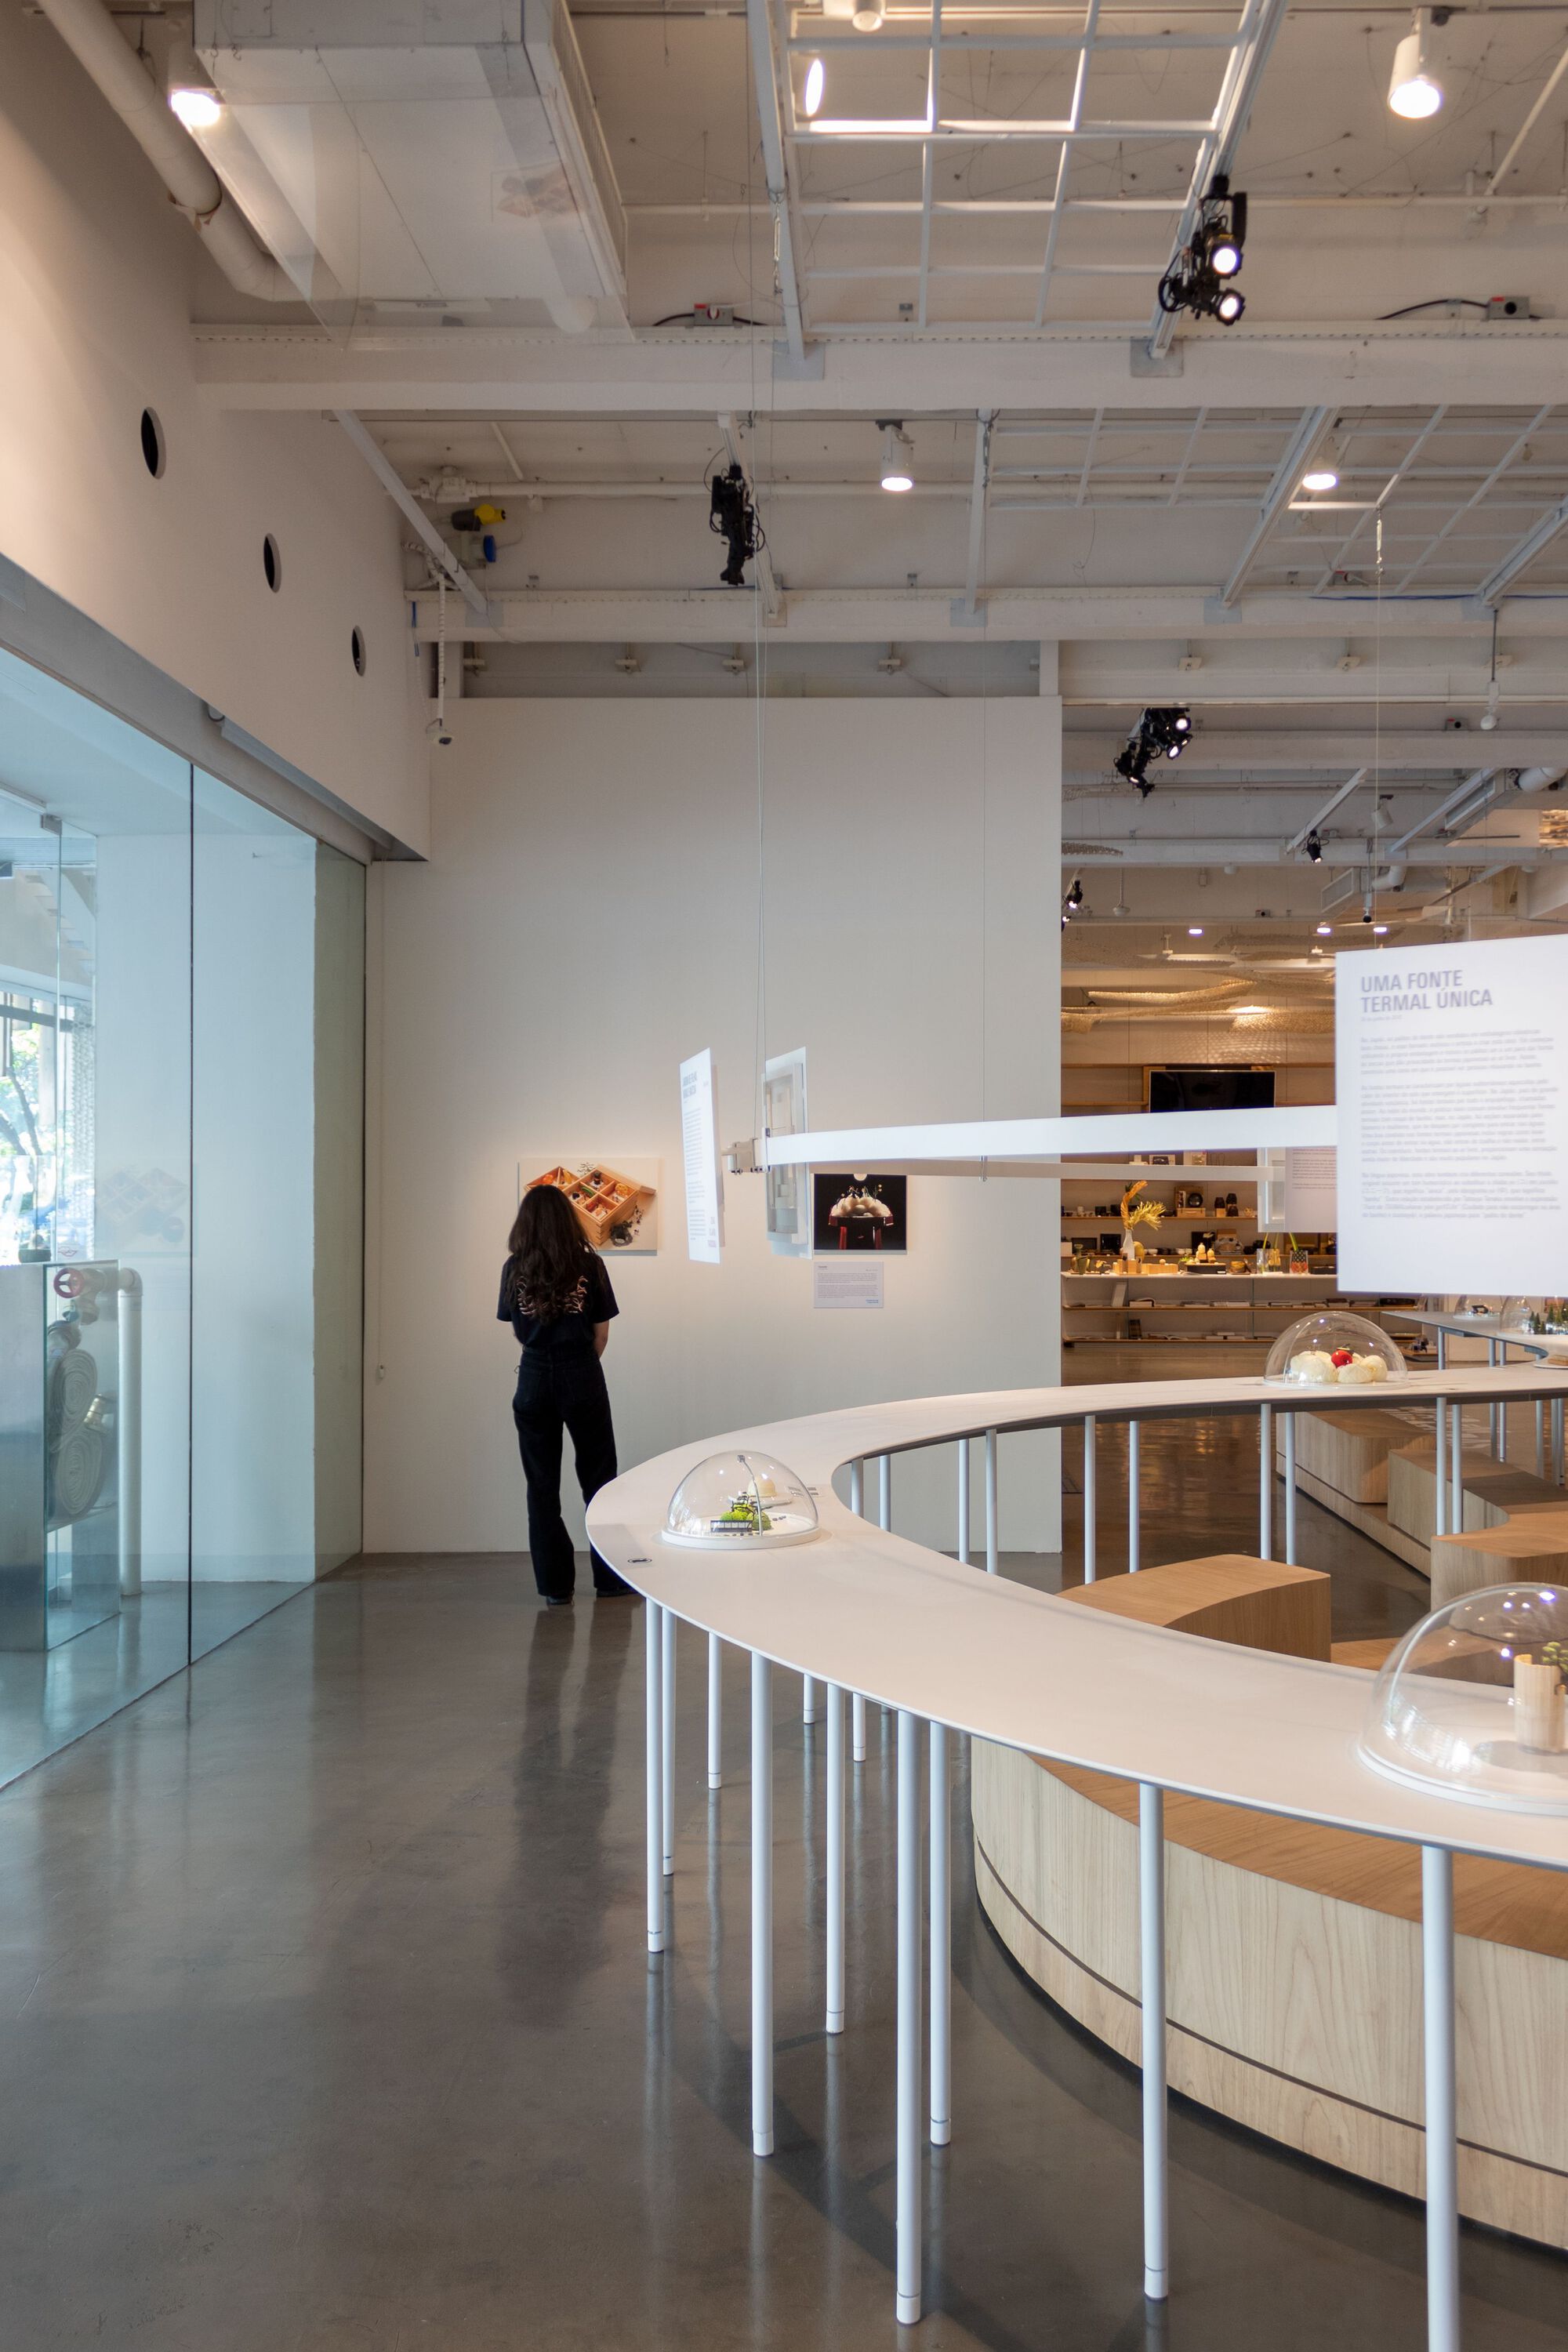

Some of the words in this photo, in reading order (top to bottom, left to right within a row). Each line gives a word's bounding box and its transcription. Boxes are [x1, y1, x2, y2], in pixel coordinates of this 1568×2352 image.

[1361, 975, 1402, 993] UMA
[1407, 970, 1463, 989] FONTE
[1360, 993, 1431, 1013] TERMAL
[1437, 988, 1494, 1008] ÚNICA
